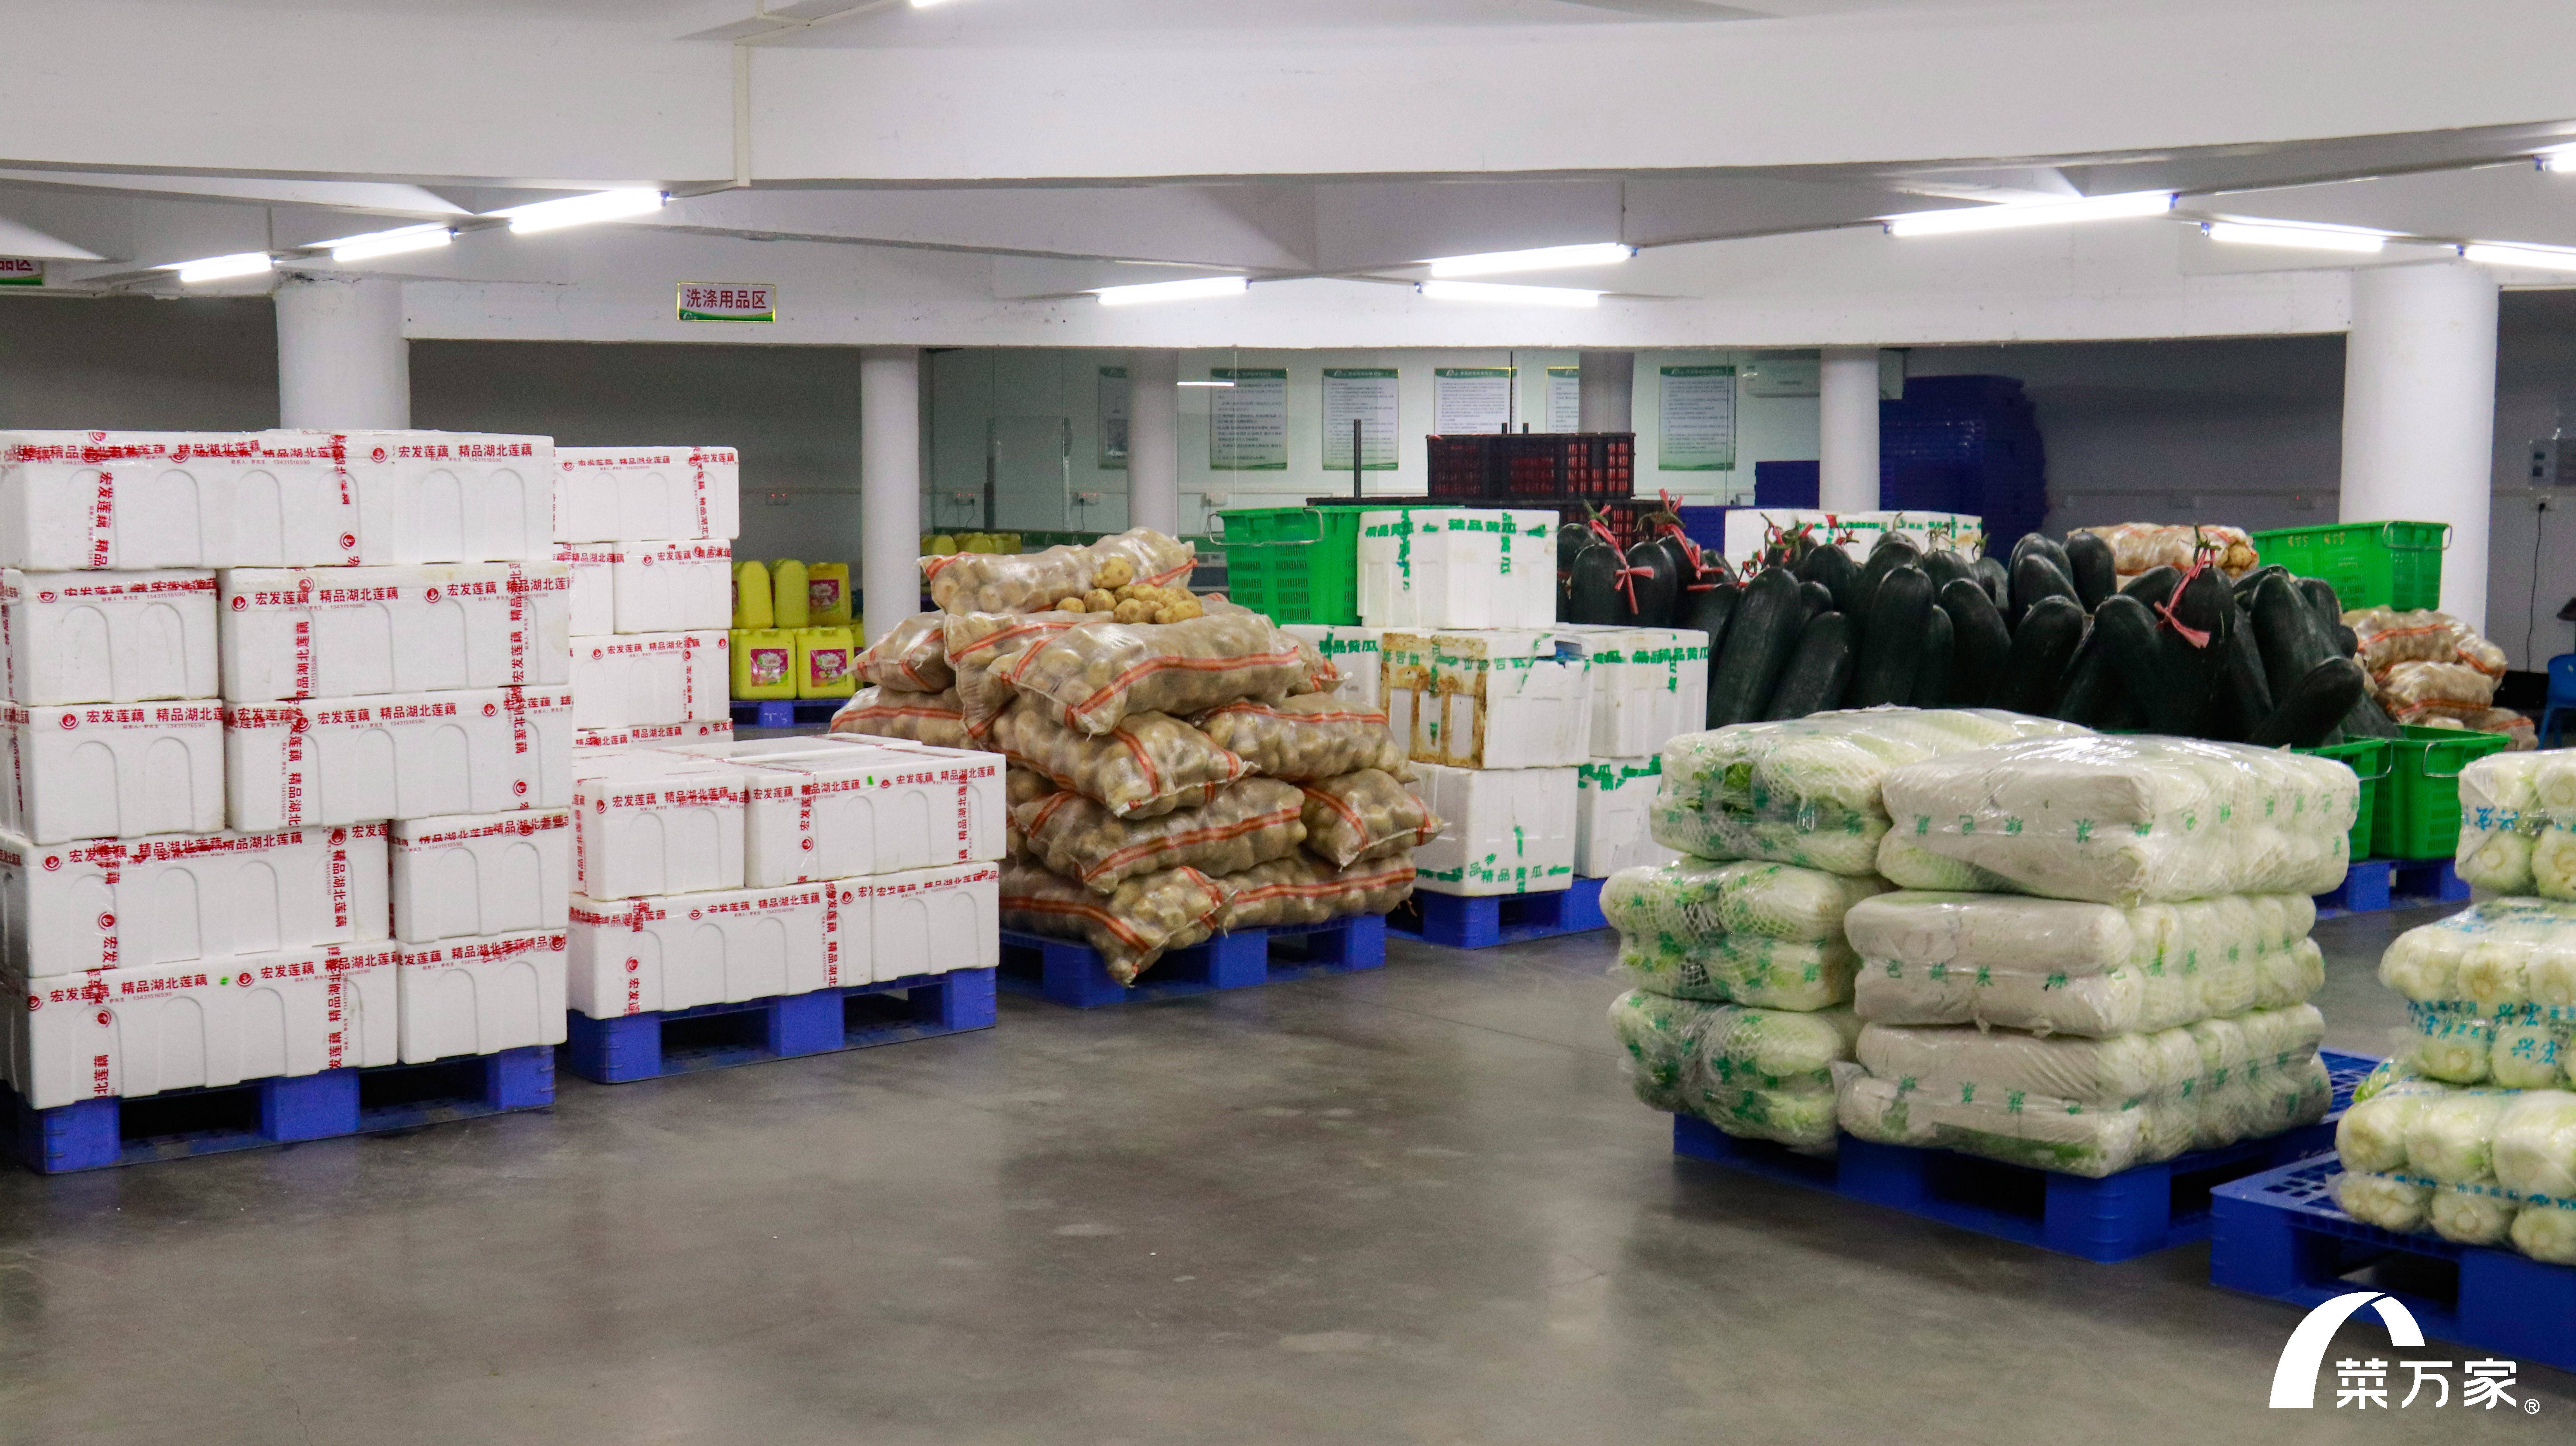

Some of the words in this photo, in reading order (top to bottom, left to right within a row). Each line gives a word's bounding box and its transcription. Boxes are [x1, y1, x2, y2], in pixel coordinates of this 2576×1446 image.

[687, 289, 766, 308] 洗涤用品区
[399, 445, 449, 458] 宏发莲藕
[459, 444, 532, 457] 精品湖北莲藕
[96, 472, 113, 528] 宏发莲藕
[658, 550, 691, 561] 宏发莲藕
[255, 591, 309, 605] 宏发莲藕
[320, 586, 398, 603] 精品湖北莲藕
[447, 581, 497, 596] 宏发莲藕
[511, 631, 524, 682] 宏发莲藕
[608, 643, 642, 654] 宏发莲藕
[86, 709, 144, 723] 宏发莲藕
[318, 708, 370, 724] 宏发莲藕
[380, 702, 457, 720] 精品湖北莲藕
[632, 726, 682, 738] 精品湖北莲藕
[896, 772, 933, 784] 宏发莲藕
[289, 772, 302, 828] 精品湖北
[613, 793, 656, 807] 宏发莲藕
[753, 785, 794, 799] 宏发莲藕
[1481, 865, 1543, 883] 精品黄瓜
[333, 850, 347, 927] 精品湖北莲藕
[261, 962, 314, 978] 宏发莲藕
[121, 974, 207, 994] 精品湖北莲藕
[94, 1054, 109, 1099] 北莲藕
